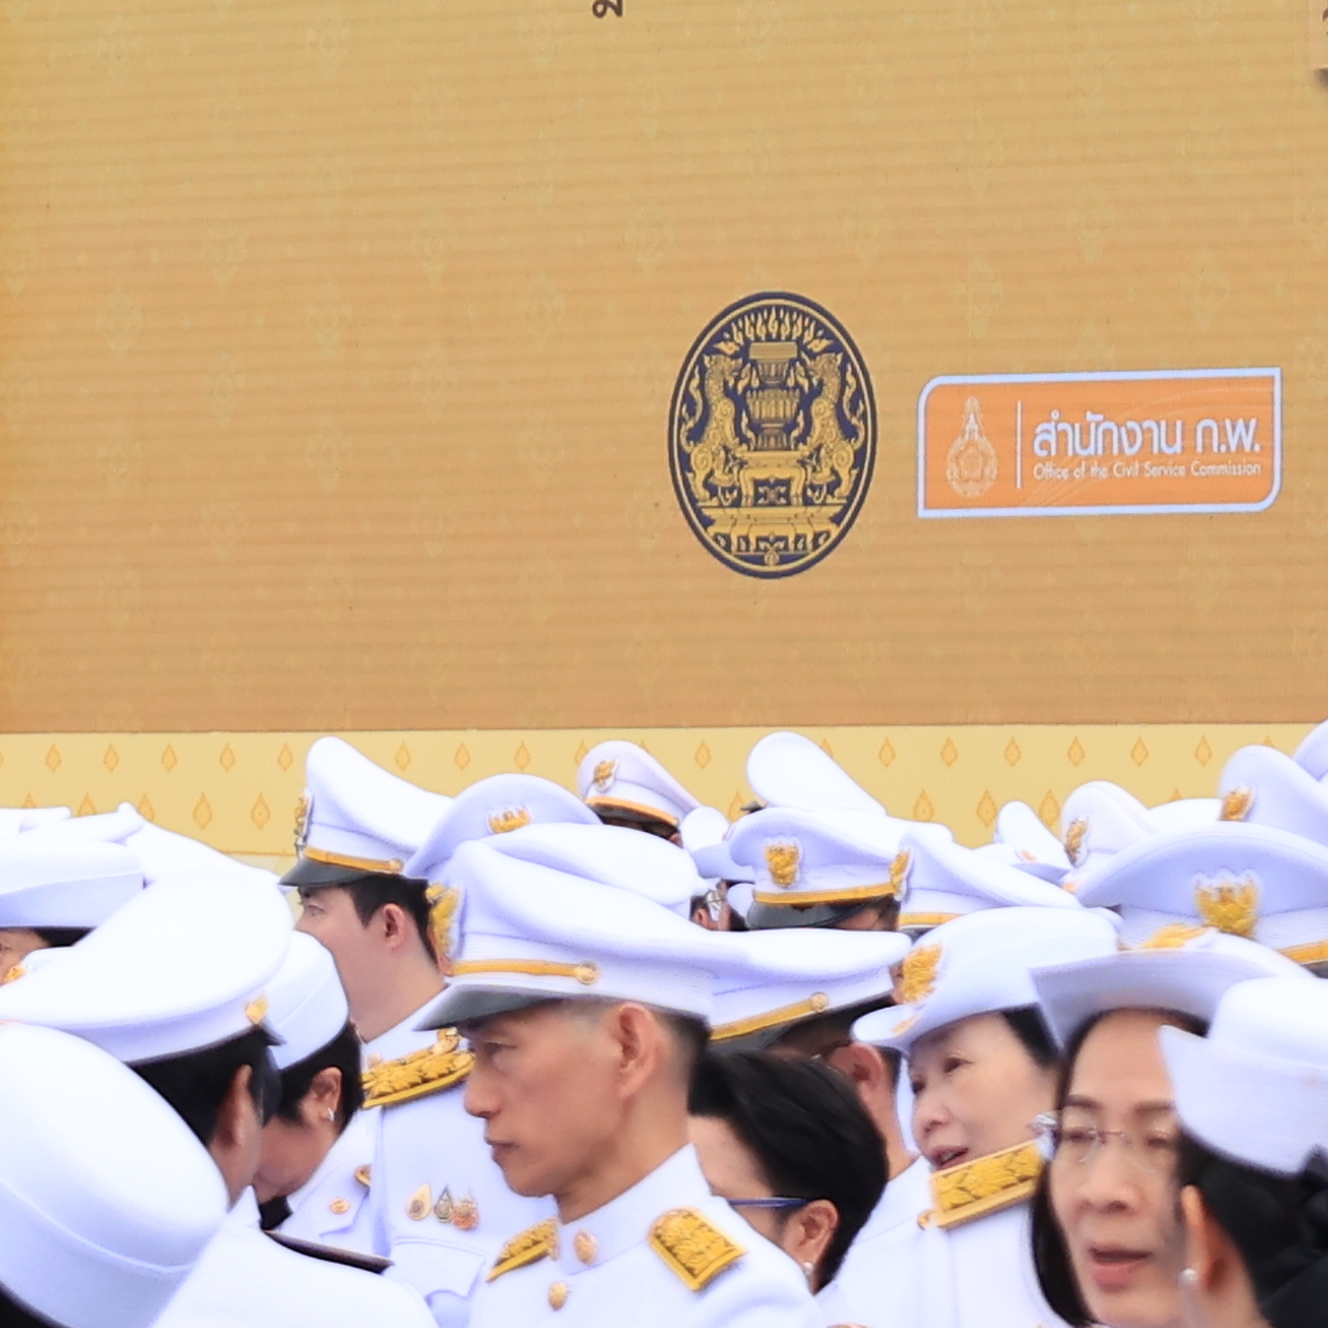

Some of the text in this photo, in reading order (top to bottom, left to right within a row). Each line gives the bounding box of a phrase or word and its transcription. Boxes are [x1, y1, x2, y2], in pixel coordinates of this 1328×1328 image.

[1033, 409, 1261, 457] สำนักงาน ก.พ.
[1033, 458, 1261, 480] Office of the Civil Service Commission
